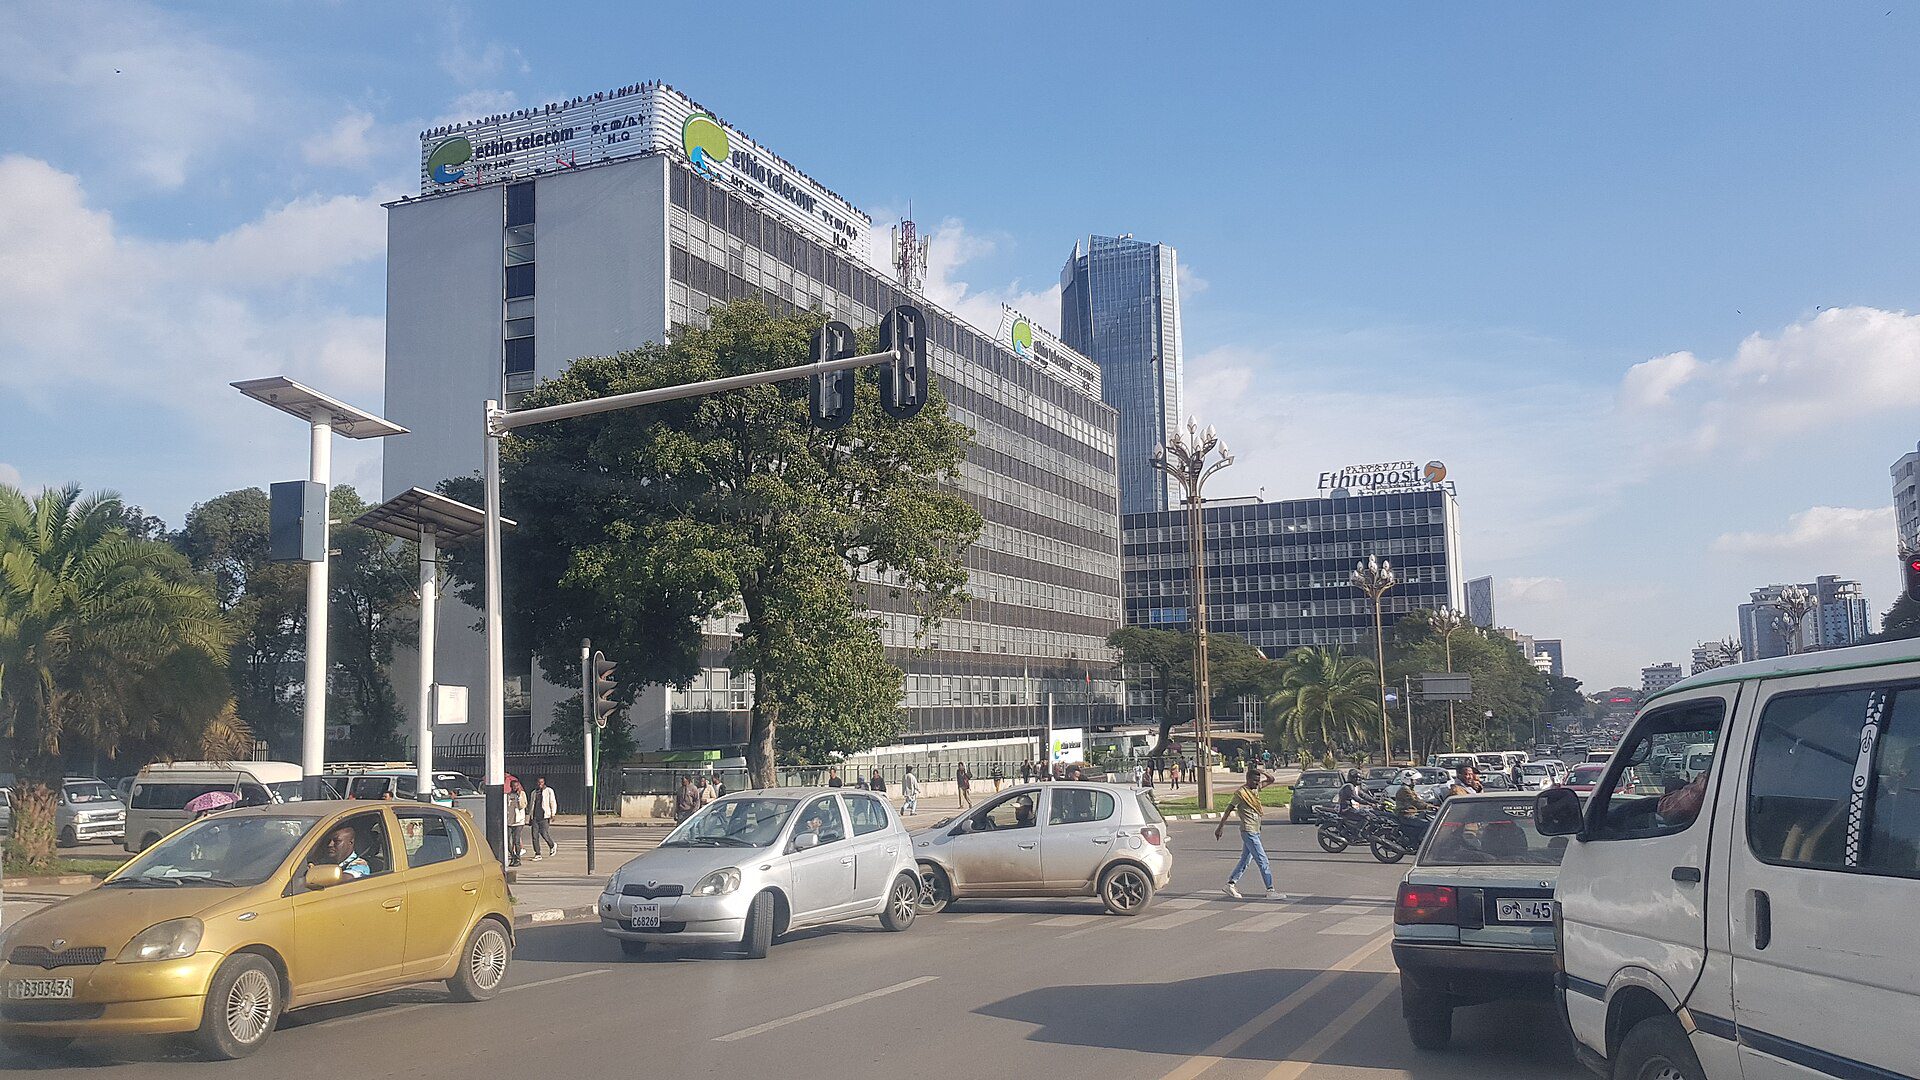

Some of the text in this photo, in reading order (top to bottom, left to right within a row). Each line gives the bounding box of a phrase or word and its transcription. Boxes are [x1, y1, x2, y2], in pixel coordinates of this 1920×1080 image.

[475, 127, 575, 159] ethio telecom
[732, 150, 817, 214] ethio telecom
[1317, 466, 1421, 491] Ethiopost
[632, 916, 659, 927] C68269
